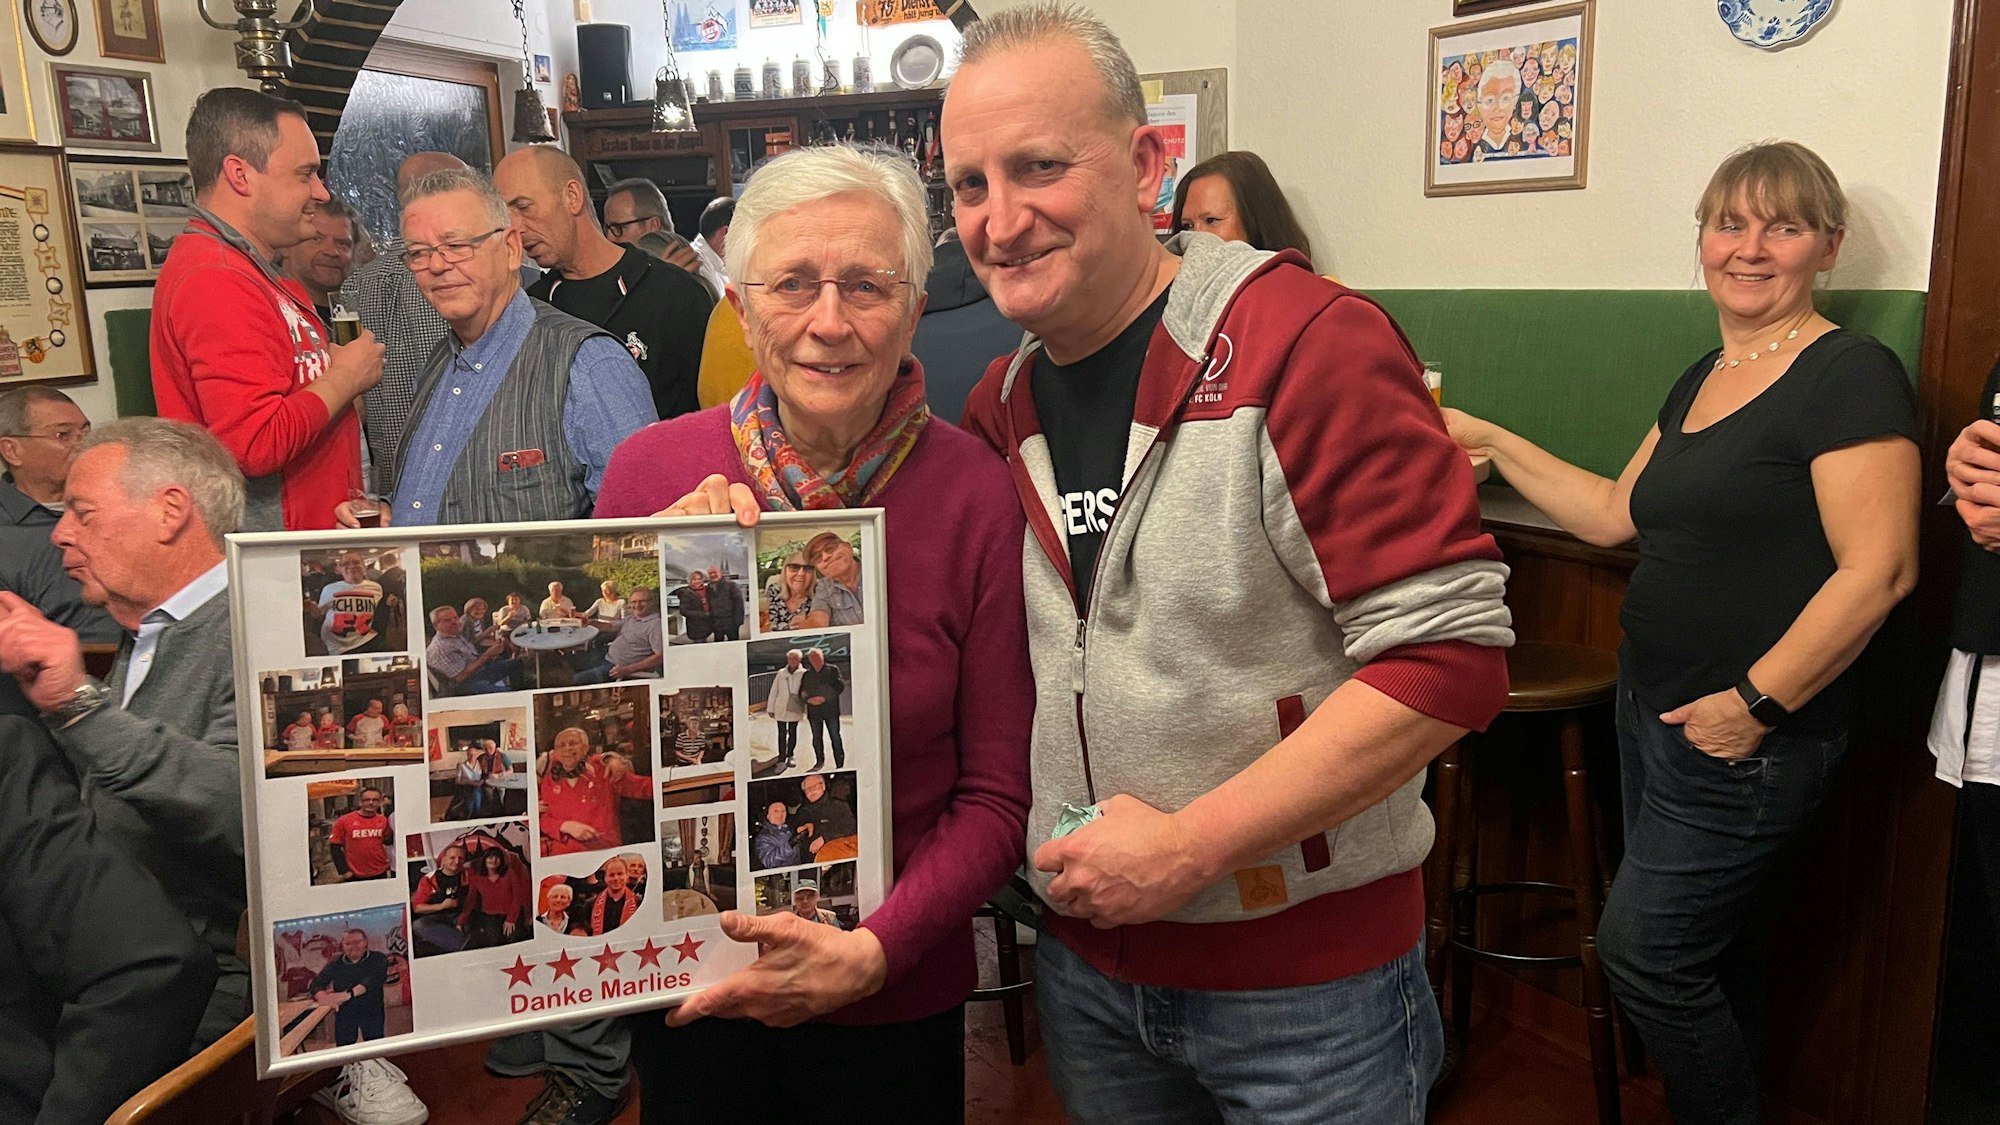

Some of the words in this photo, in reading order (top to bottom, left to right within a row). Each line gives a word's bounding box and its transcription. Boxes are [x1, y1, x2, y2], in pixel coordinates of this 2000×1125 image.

[1194, 394, 1204, 404] FC
[1204, 392, 1223, 403] KÖLN
[1059, 487, 1119, 536] ERS
[332, 598, 353, 612] ICH
[356, 598, 376, 612] BIN
[352, 828, 383, 839] REWE
[510, 986, 593, 1015] Danke
[601, 971, 692, 1000] Marlies
